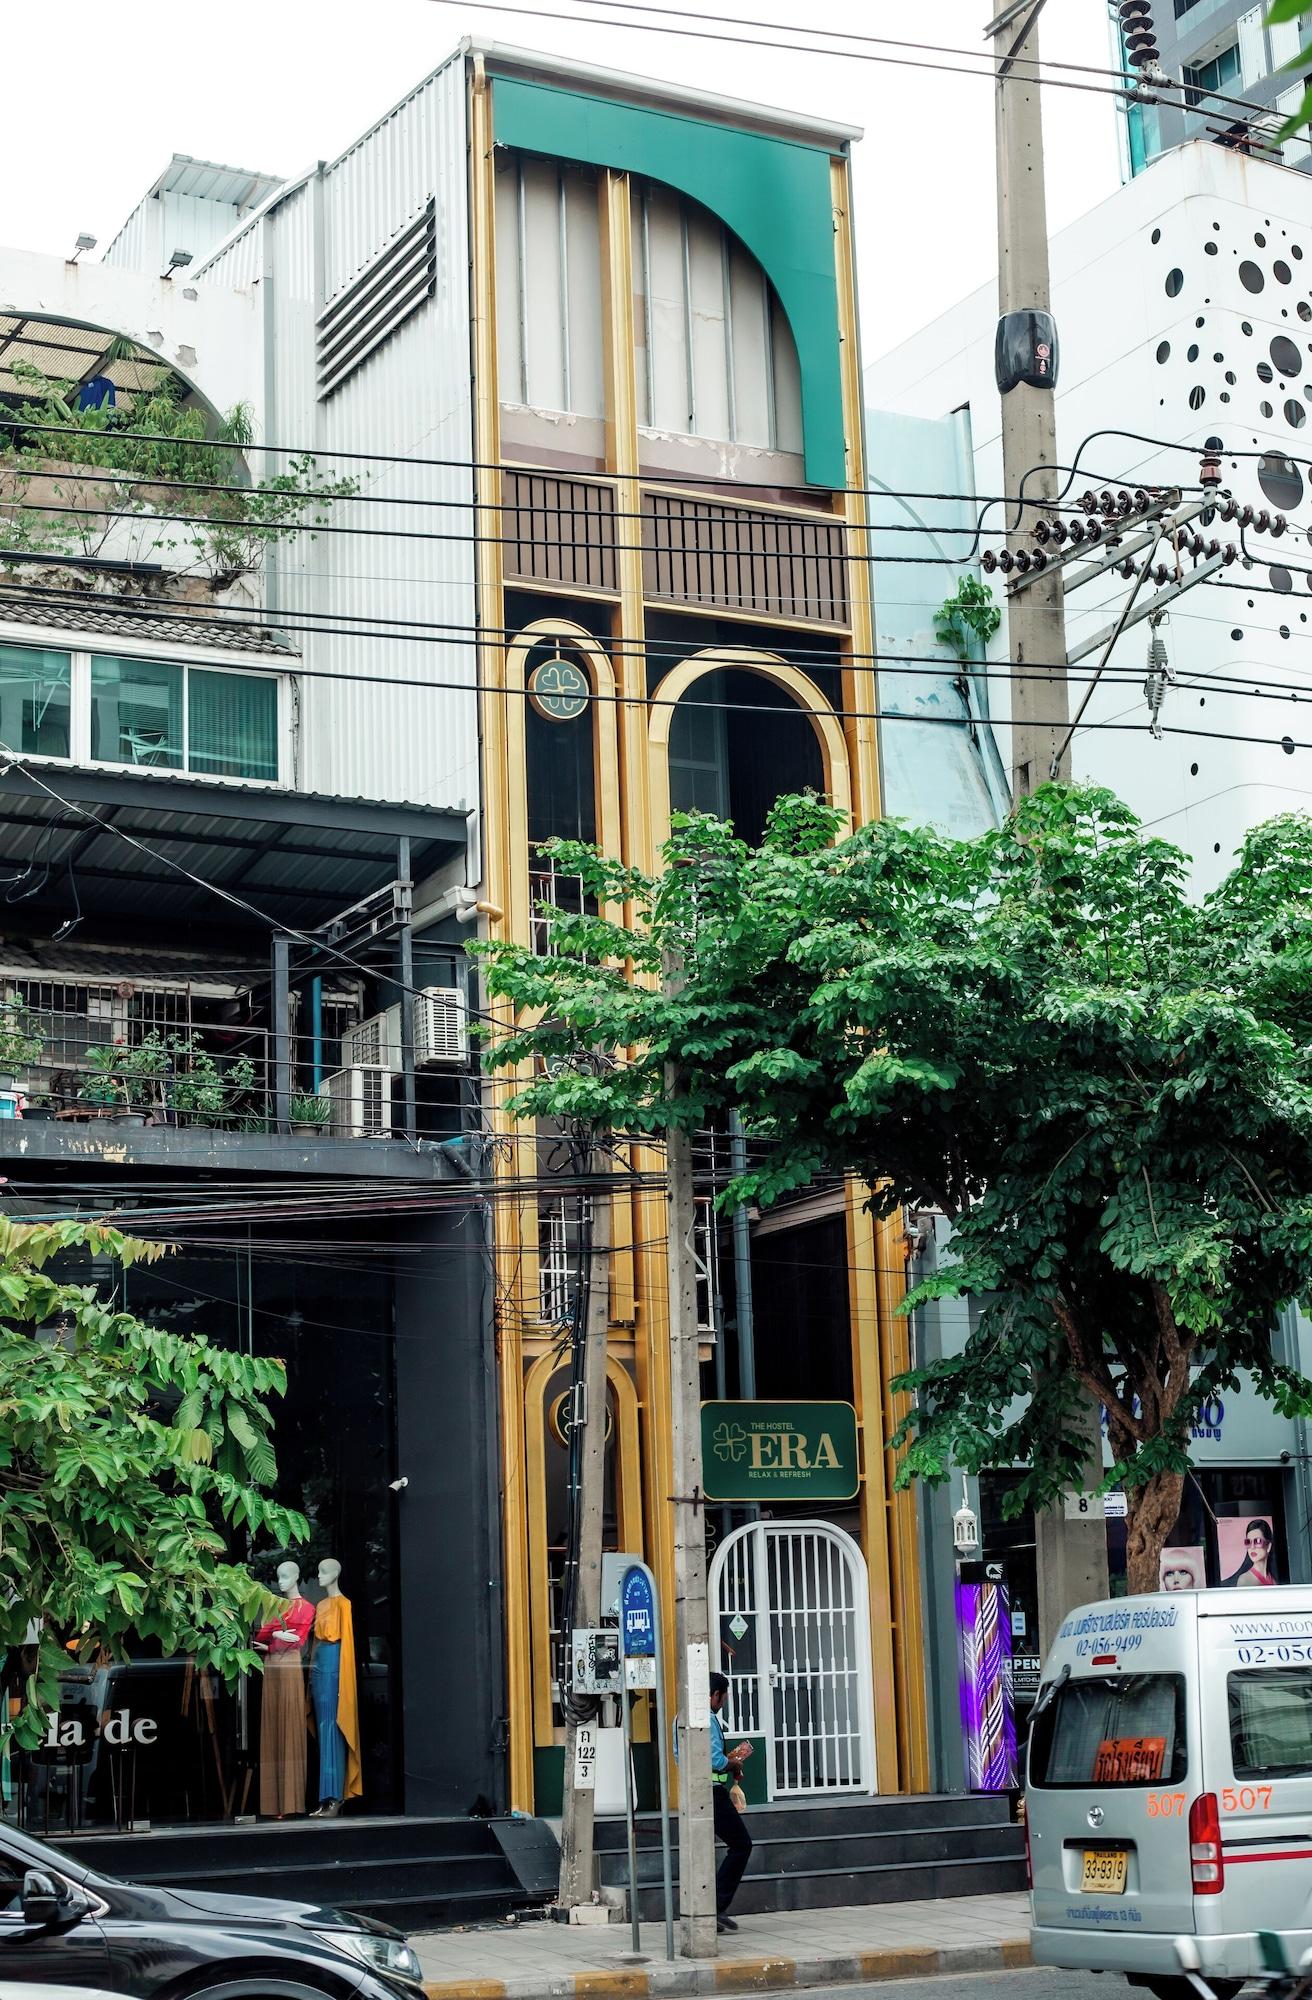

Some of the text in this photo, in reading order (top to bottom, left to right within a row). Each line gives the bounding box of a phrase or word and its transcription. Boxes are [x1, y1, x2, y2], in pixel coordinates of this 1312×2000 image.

[751, 1422, 795, 1430] THE HOSTEL
[747, 1433, 844, 1469] ERA
[1079, 1498, 1088, 1512] 8
[1076, 1634, 1142, 1656] 02-056-9499
[1004, 1658, 1040, 1670] OPEN
[104, 1708, 158, 1745] de
[578, 1746, 595, 1759] 122
[581, 1765, 588, 1777] 3
[1147, 1793, 1186, 1817] 507
[1222, 1786, 1273, 1811] 507
